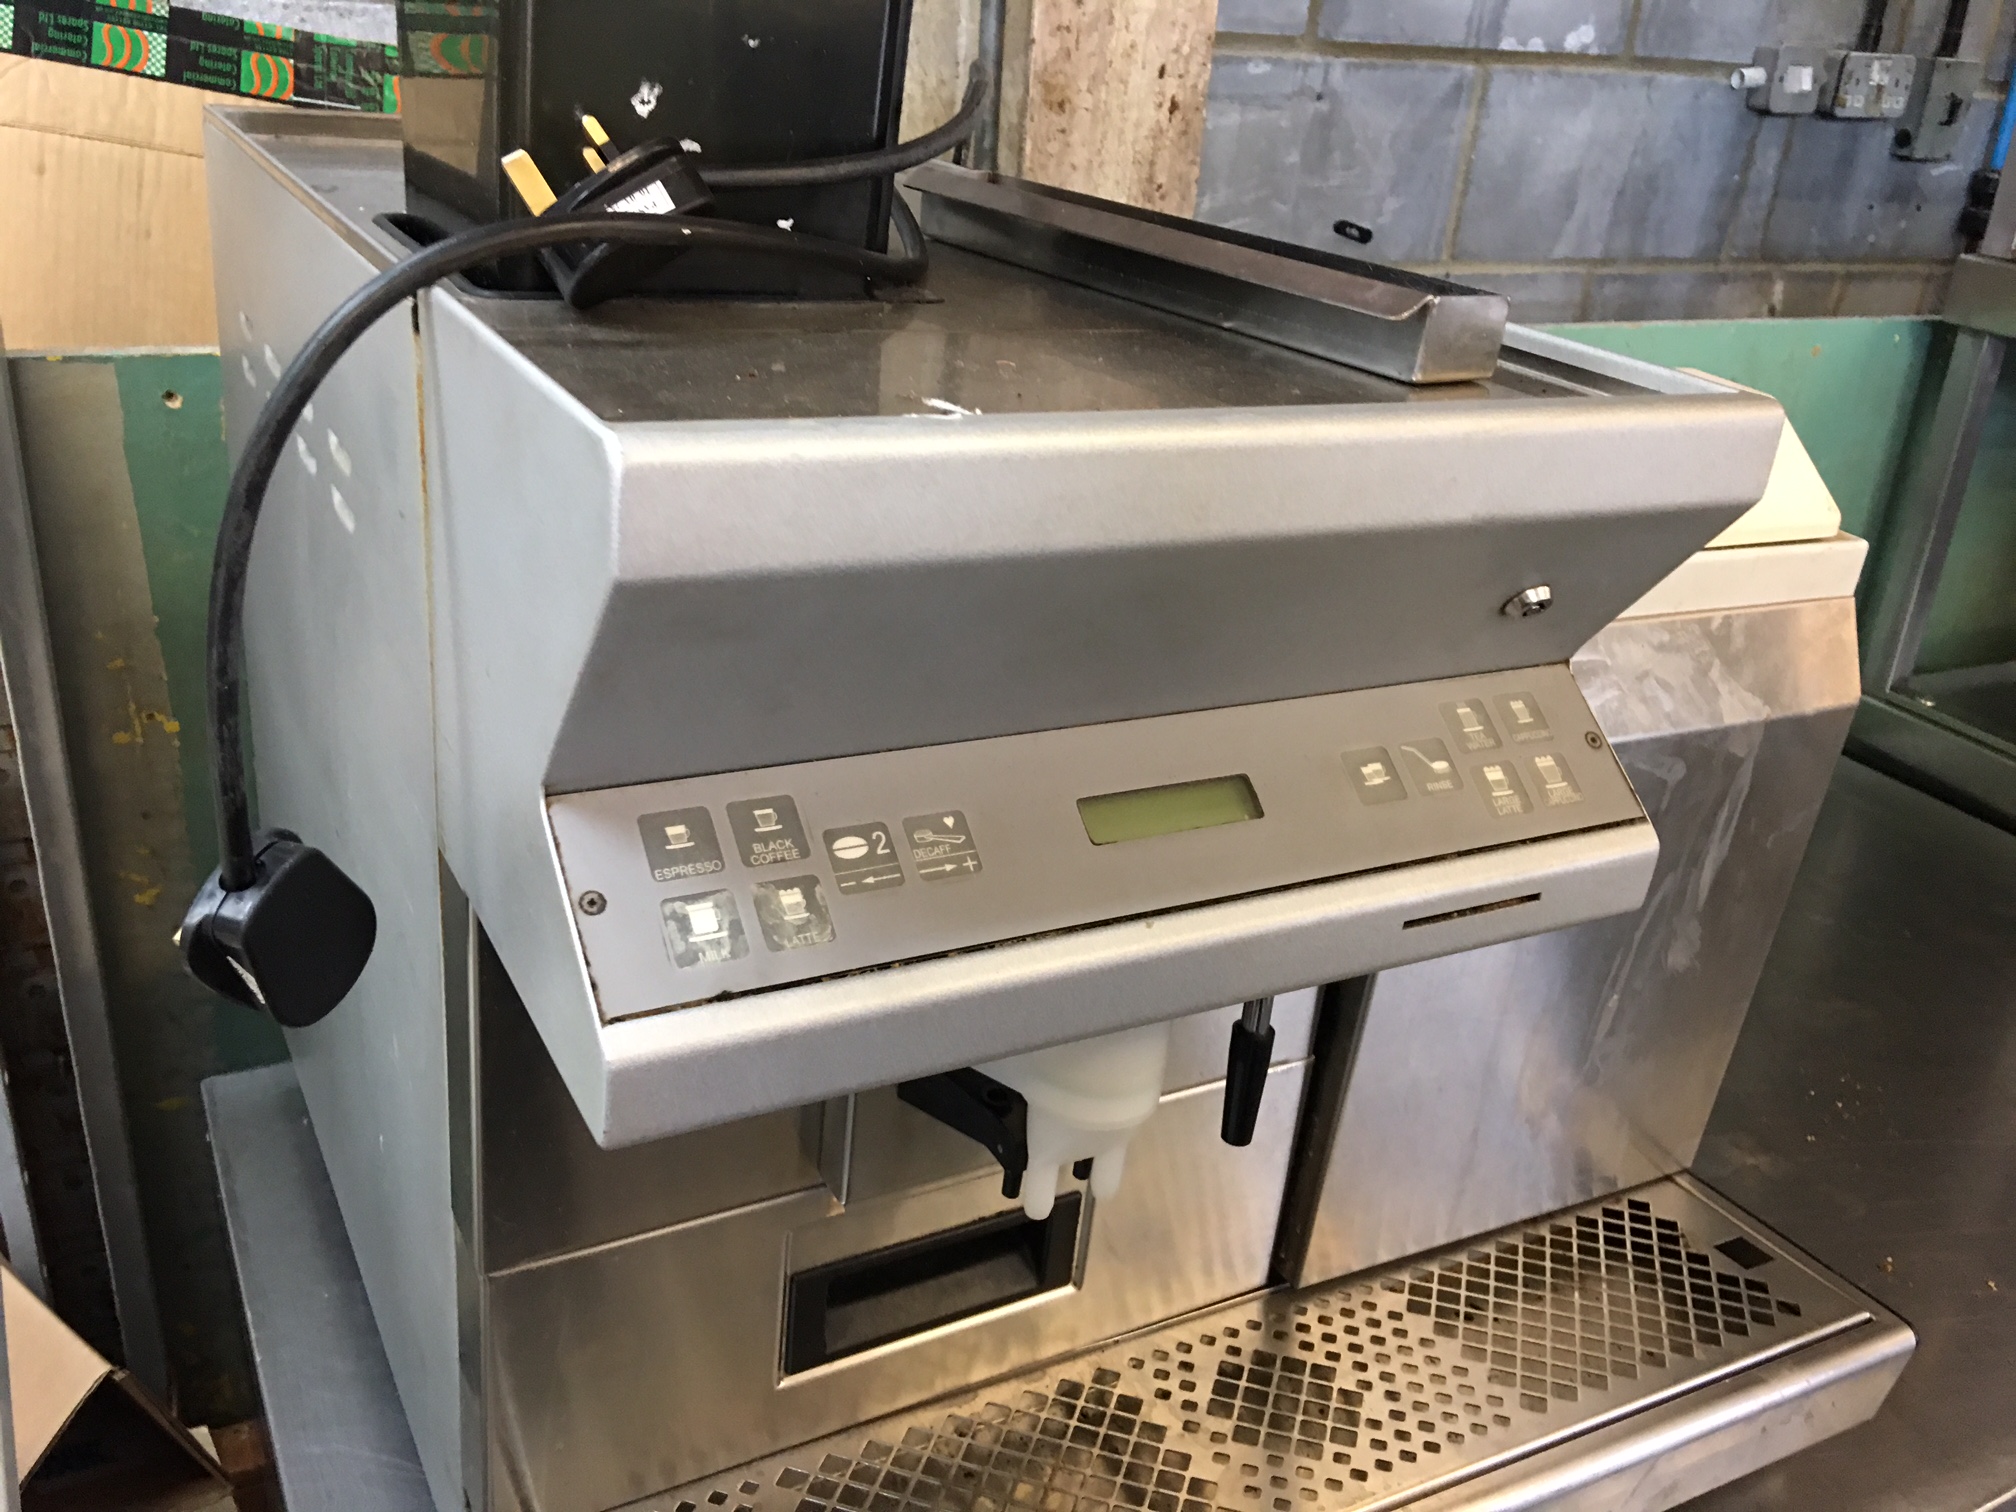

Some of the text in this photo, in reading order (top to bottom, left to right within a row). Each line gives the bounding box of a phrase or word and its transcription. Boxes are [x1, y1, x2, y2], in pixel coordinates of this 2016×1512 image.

[38, 11, 54, 25] Ltd
[57, 14, 89, 32] Spares
[48, 27, 88, 47] Catering
[31, 41, 87, 63] Commercial
[199, 56, 237, 75] Catering
[183, 70, 237, 91] Commercial
[1497, 803, 1523, 816] LATTE
[752, 838, 794, 854] BLACK
[871, 831, 891, 855] 2
[913, 844, 951, 859] DECAFF
[750, 848, 800, 865] COFFEE
[654, 859, 722, 881] ESPRESSO
[784, 931, 820, 948] LATTE
[698, 949, 731, 965] MILK
